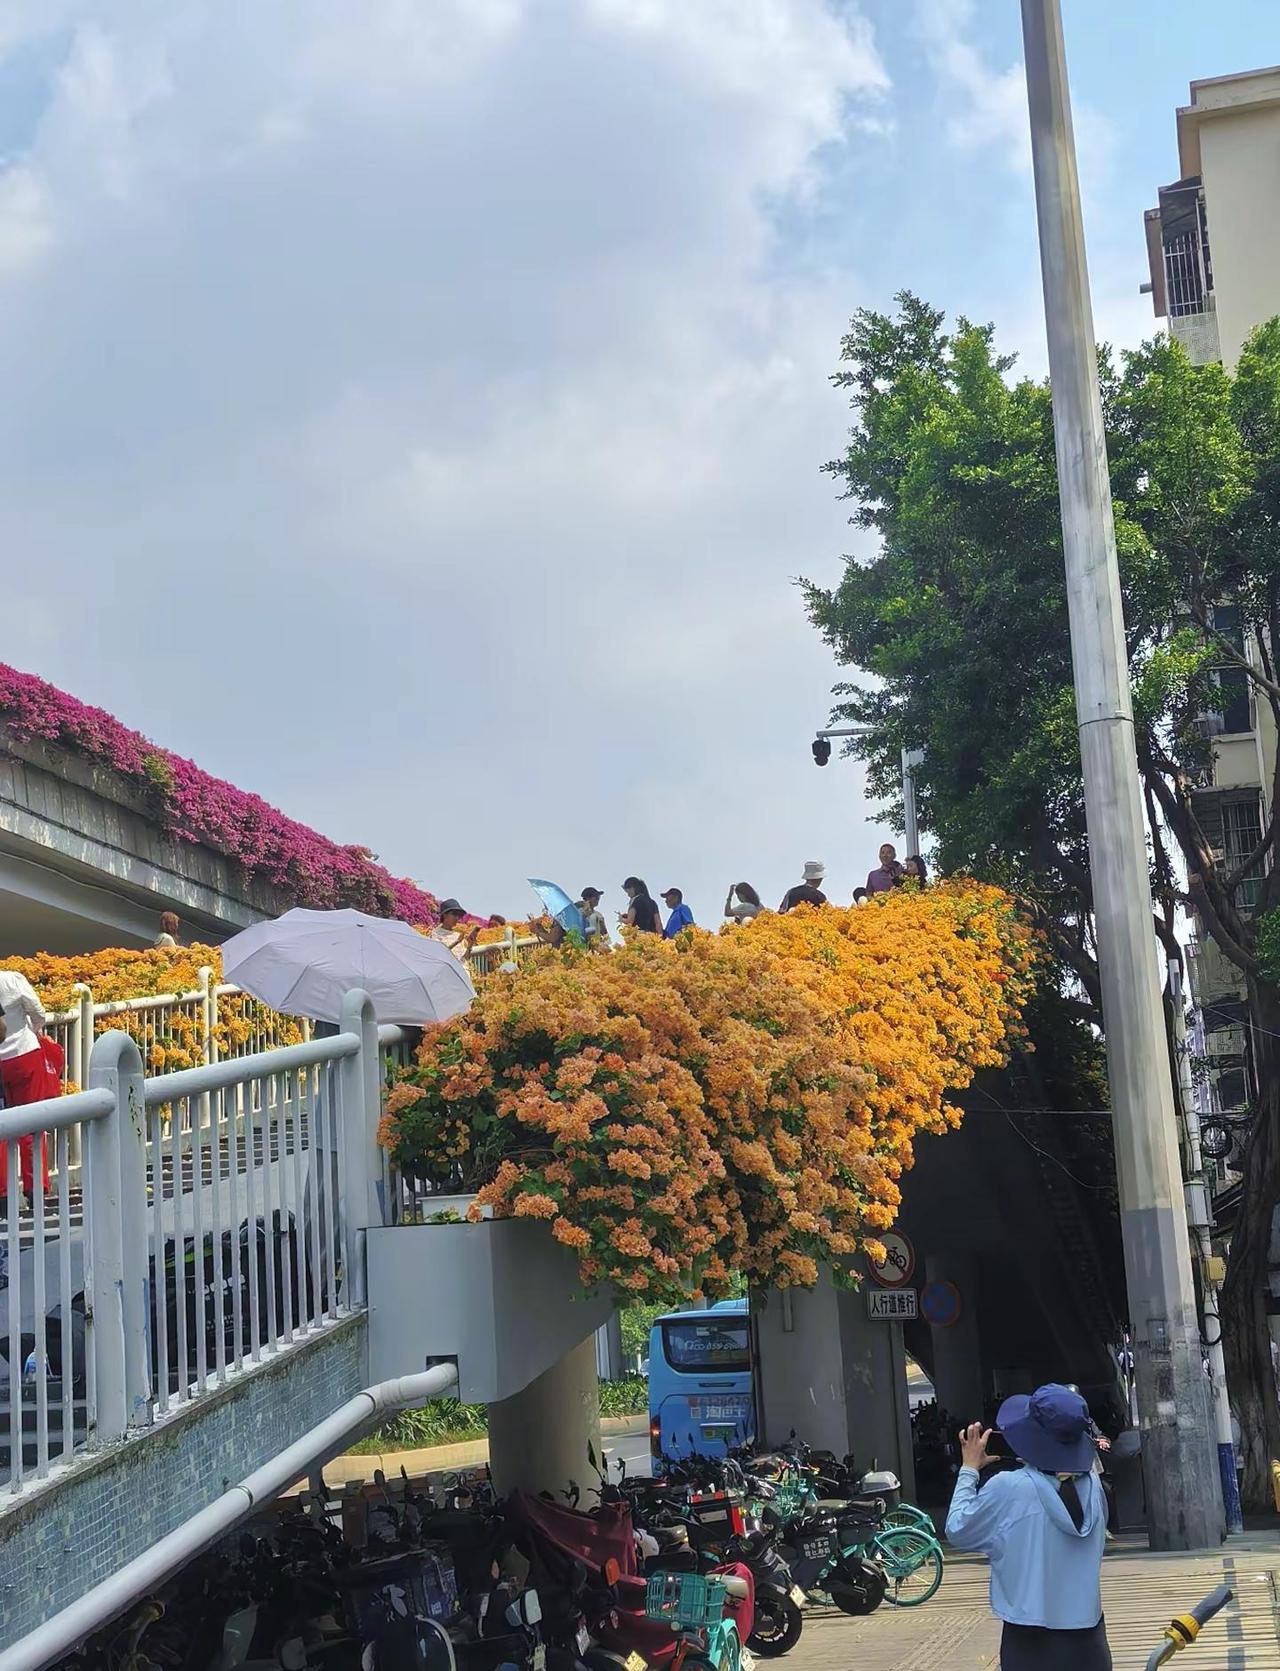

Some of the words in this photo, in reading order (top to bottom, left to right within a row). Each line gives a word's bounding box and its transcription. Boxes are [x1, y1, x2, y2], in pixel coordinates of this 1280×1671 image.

[872, 1294, 914, 1314] 人行道推行
